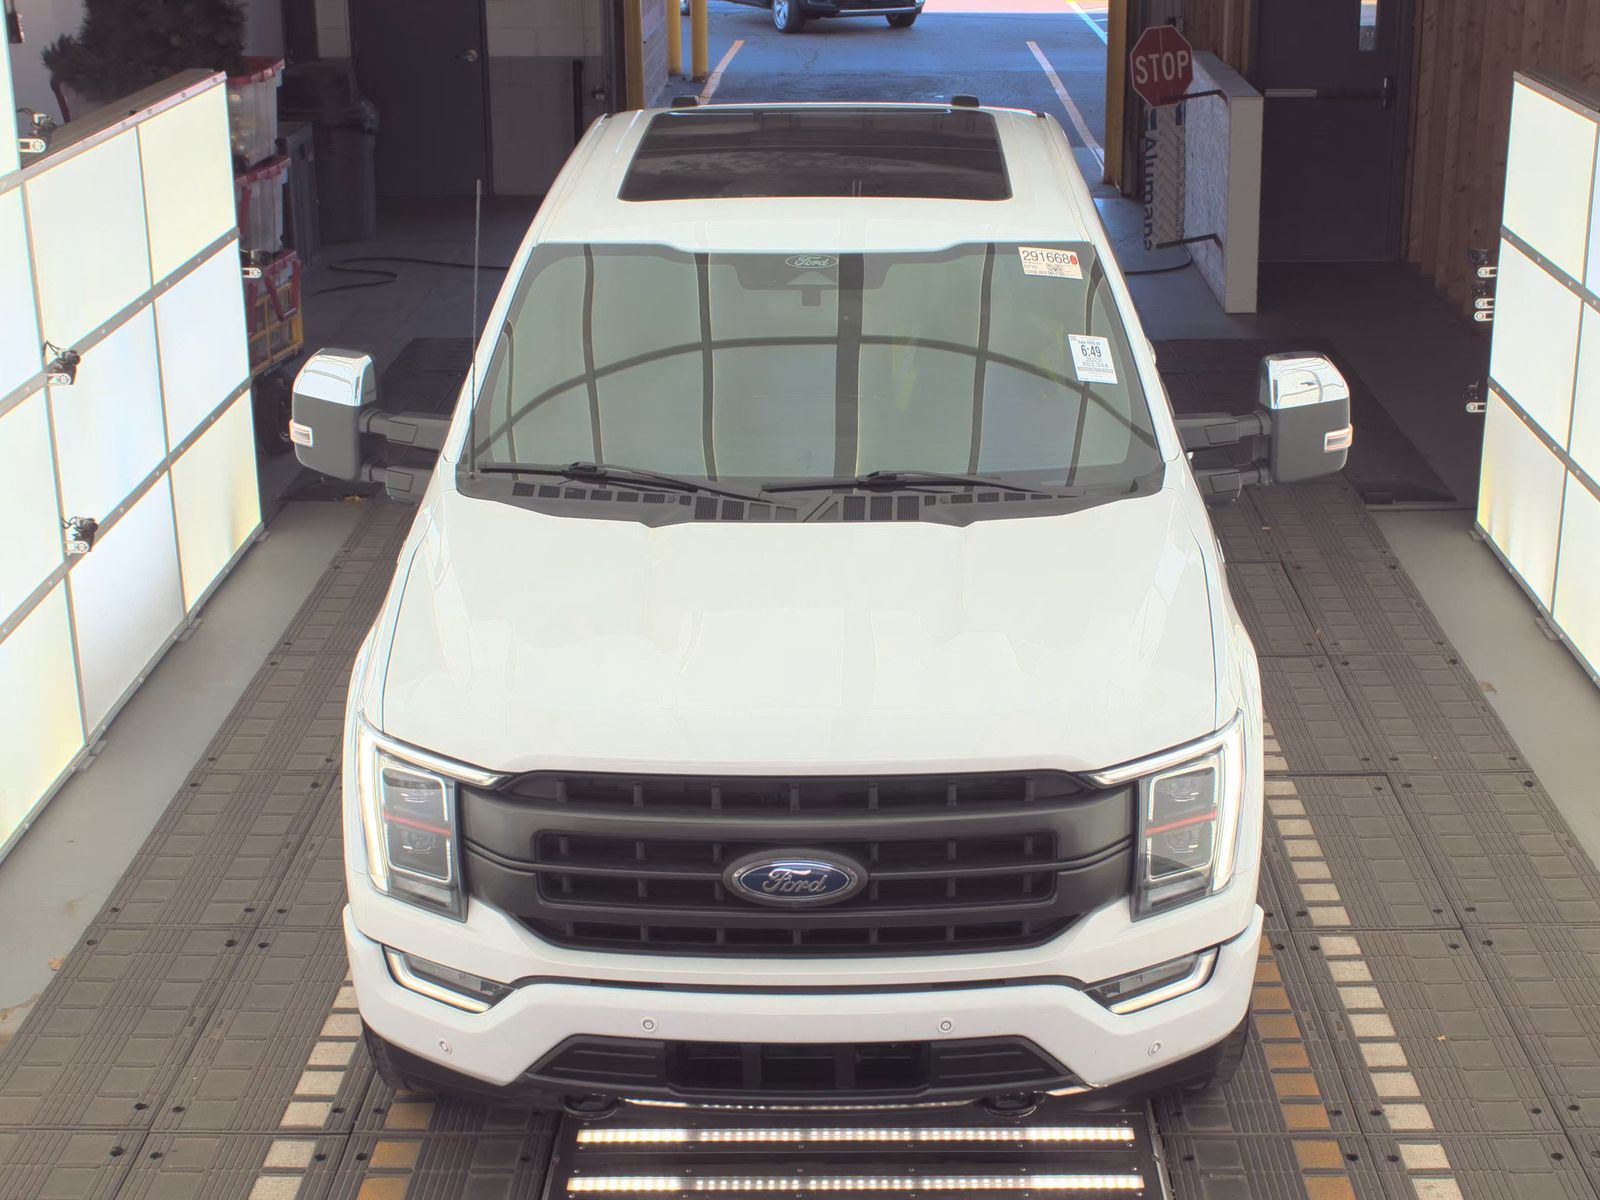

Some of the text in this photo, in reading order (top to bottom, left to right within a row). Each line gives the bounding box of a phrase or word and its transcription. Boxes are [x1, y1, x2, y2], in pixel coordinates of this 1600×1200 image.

[1135, 49, 1190, 85] STOP
[794, 256, 830, 267] Ford
[1080, 344, 1102, 358] 6:49
[762, 867, 829, 893] Ford
